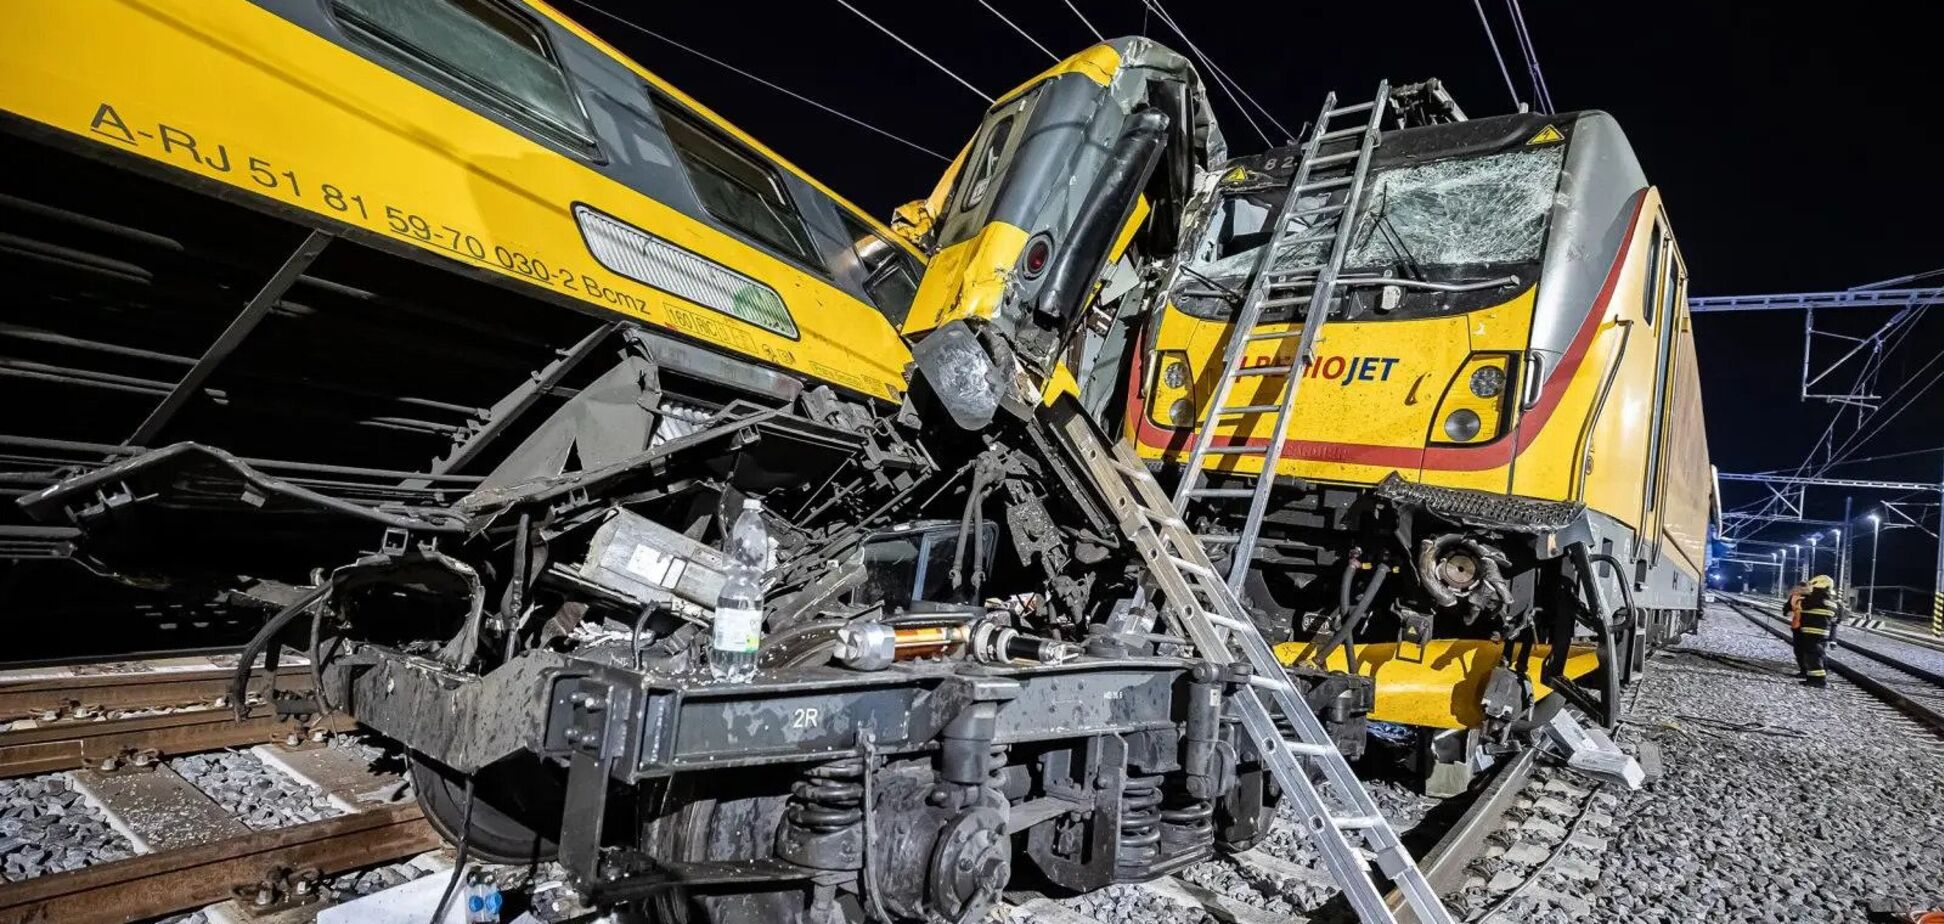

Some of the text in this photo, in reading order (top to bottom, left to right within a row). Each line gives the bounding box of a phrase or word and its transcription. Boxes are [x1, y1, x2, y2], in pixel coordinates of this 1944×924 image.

[91, 103, 651, 315] A-RJ 51 81 59-70 030-2 Bcmz
[793, 708, 818, 728] 2R
